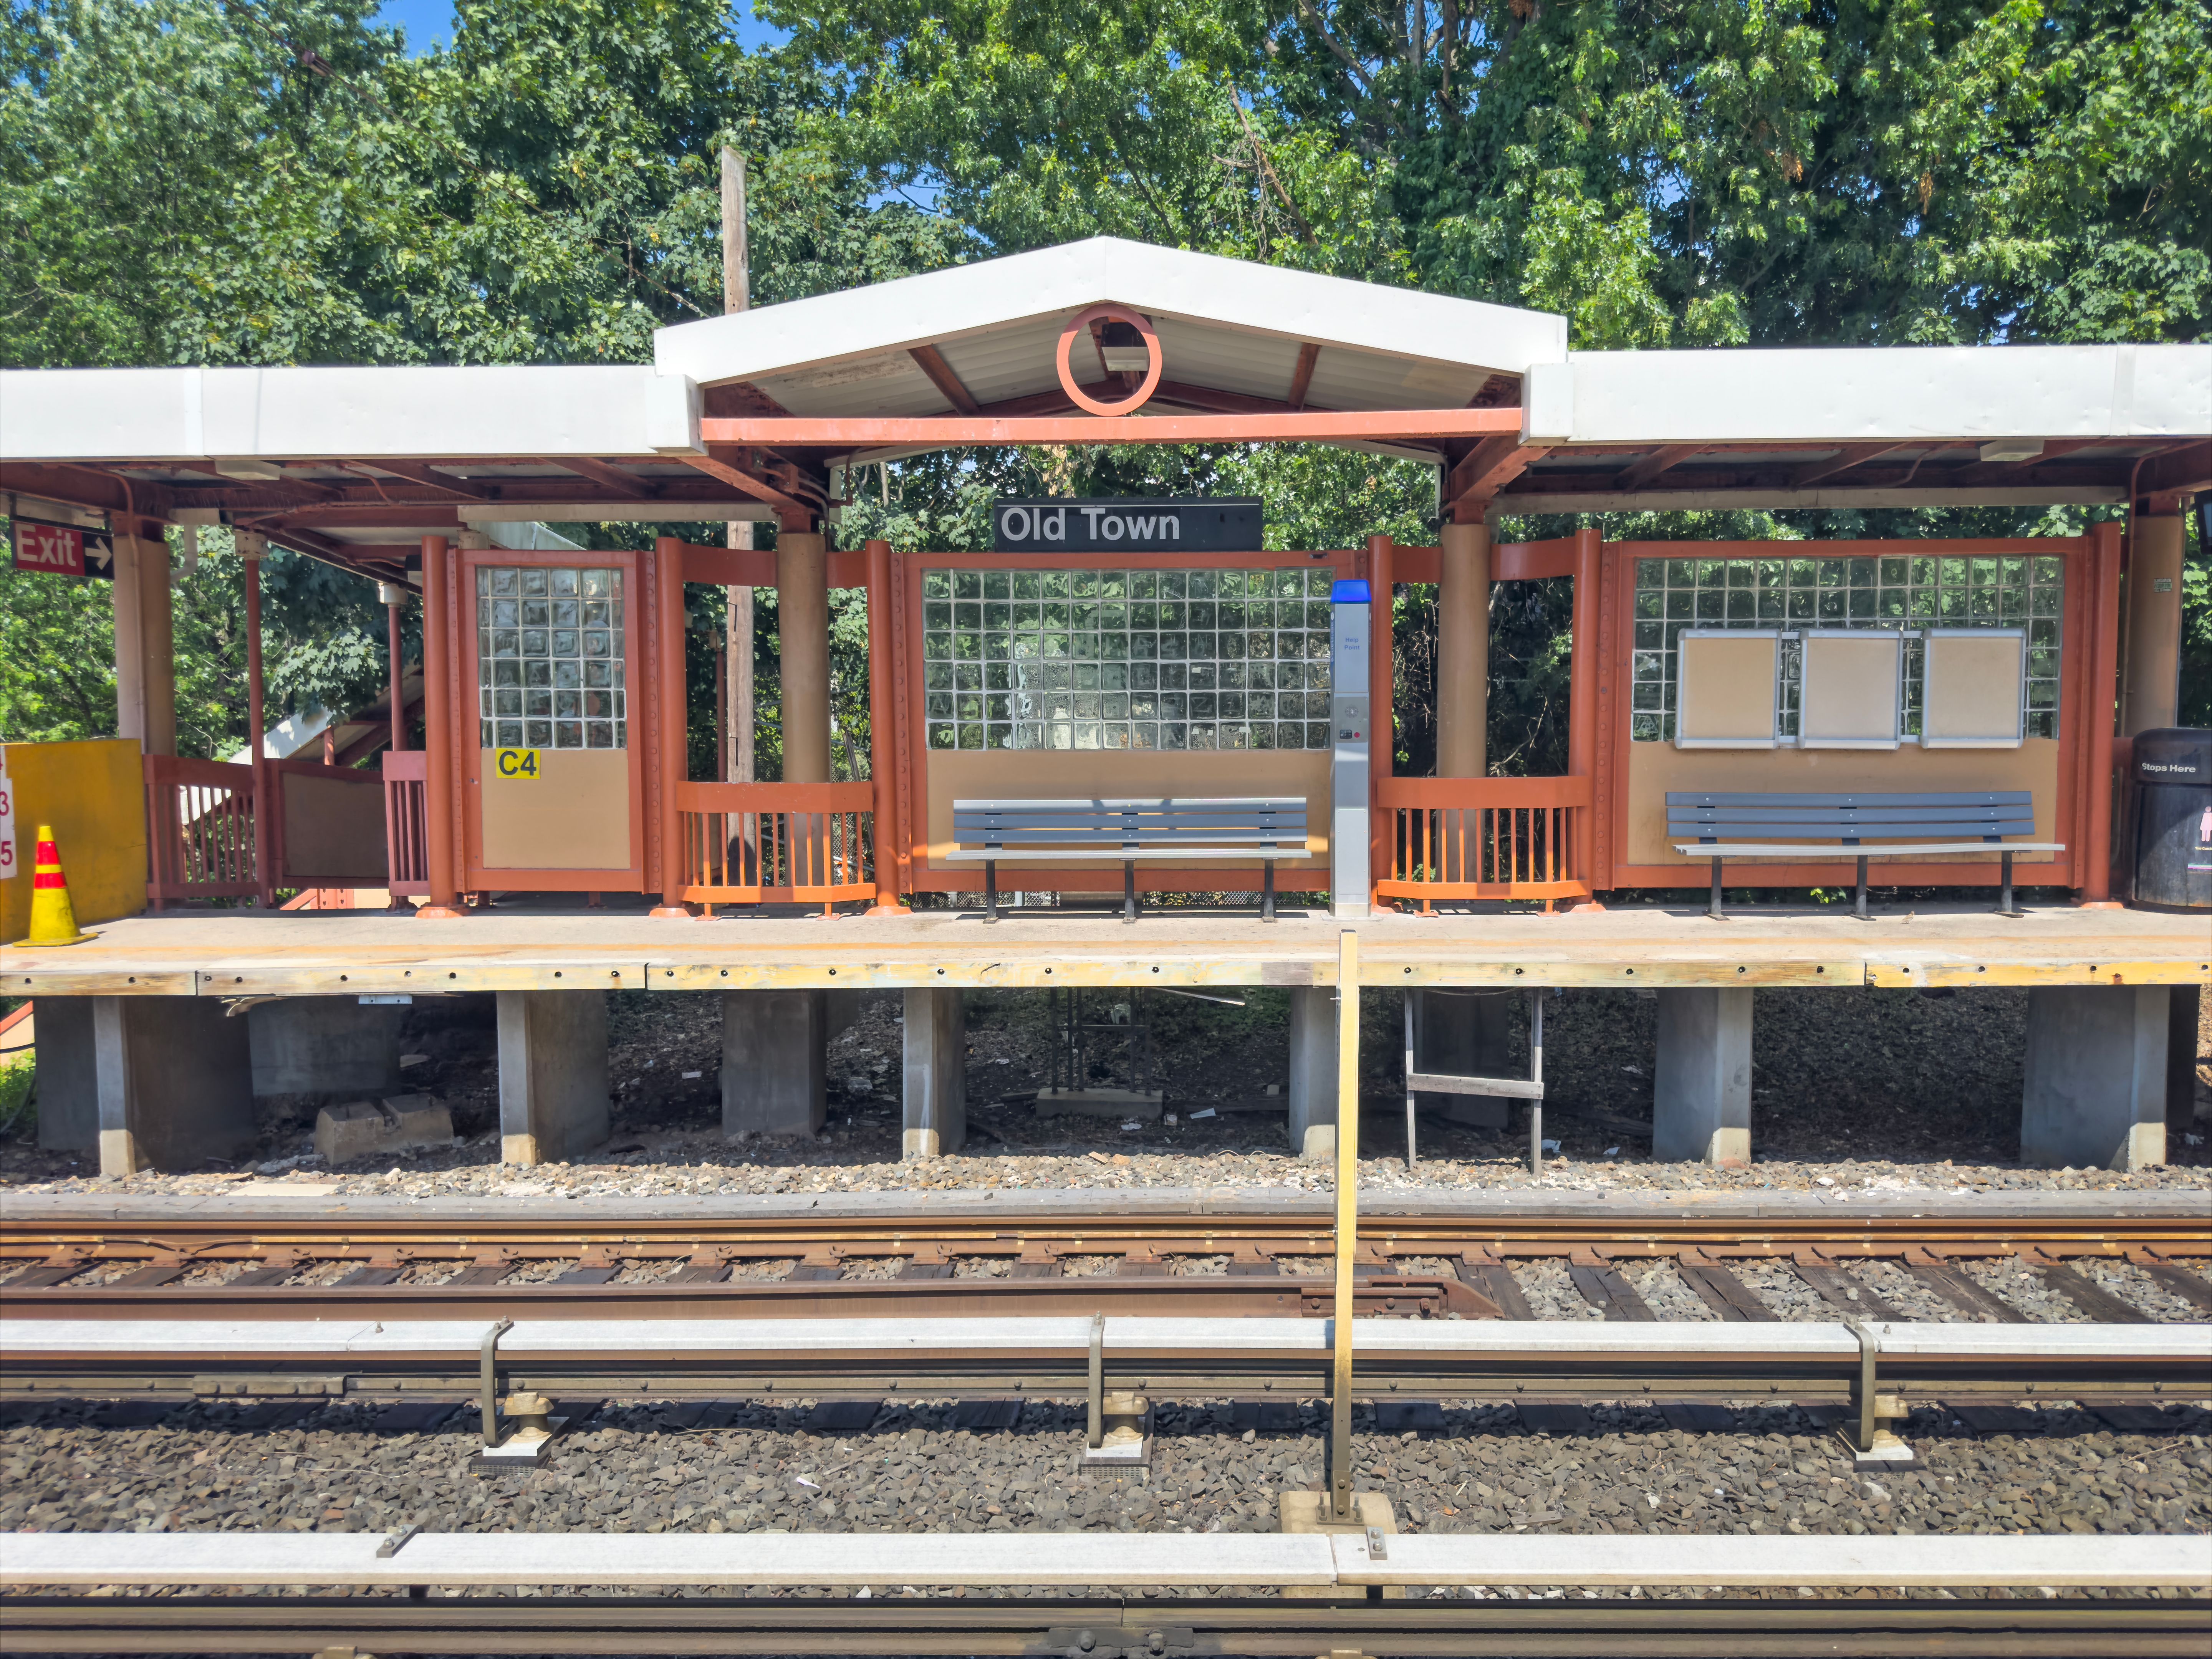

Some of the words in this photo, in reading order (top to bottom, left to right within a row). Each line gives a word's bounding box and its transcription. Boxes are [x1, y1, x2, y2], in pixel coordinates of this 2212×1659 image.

[1001, 507, 1065, 541] Old
[1081, 508, 1179, 540] Town
[15, 523, 76, 566] Exit
[499, 751, 536, 776] C4
[2142, 763, 2167, 772] Stops
[2169, 765, 2196, 773] Here
